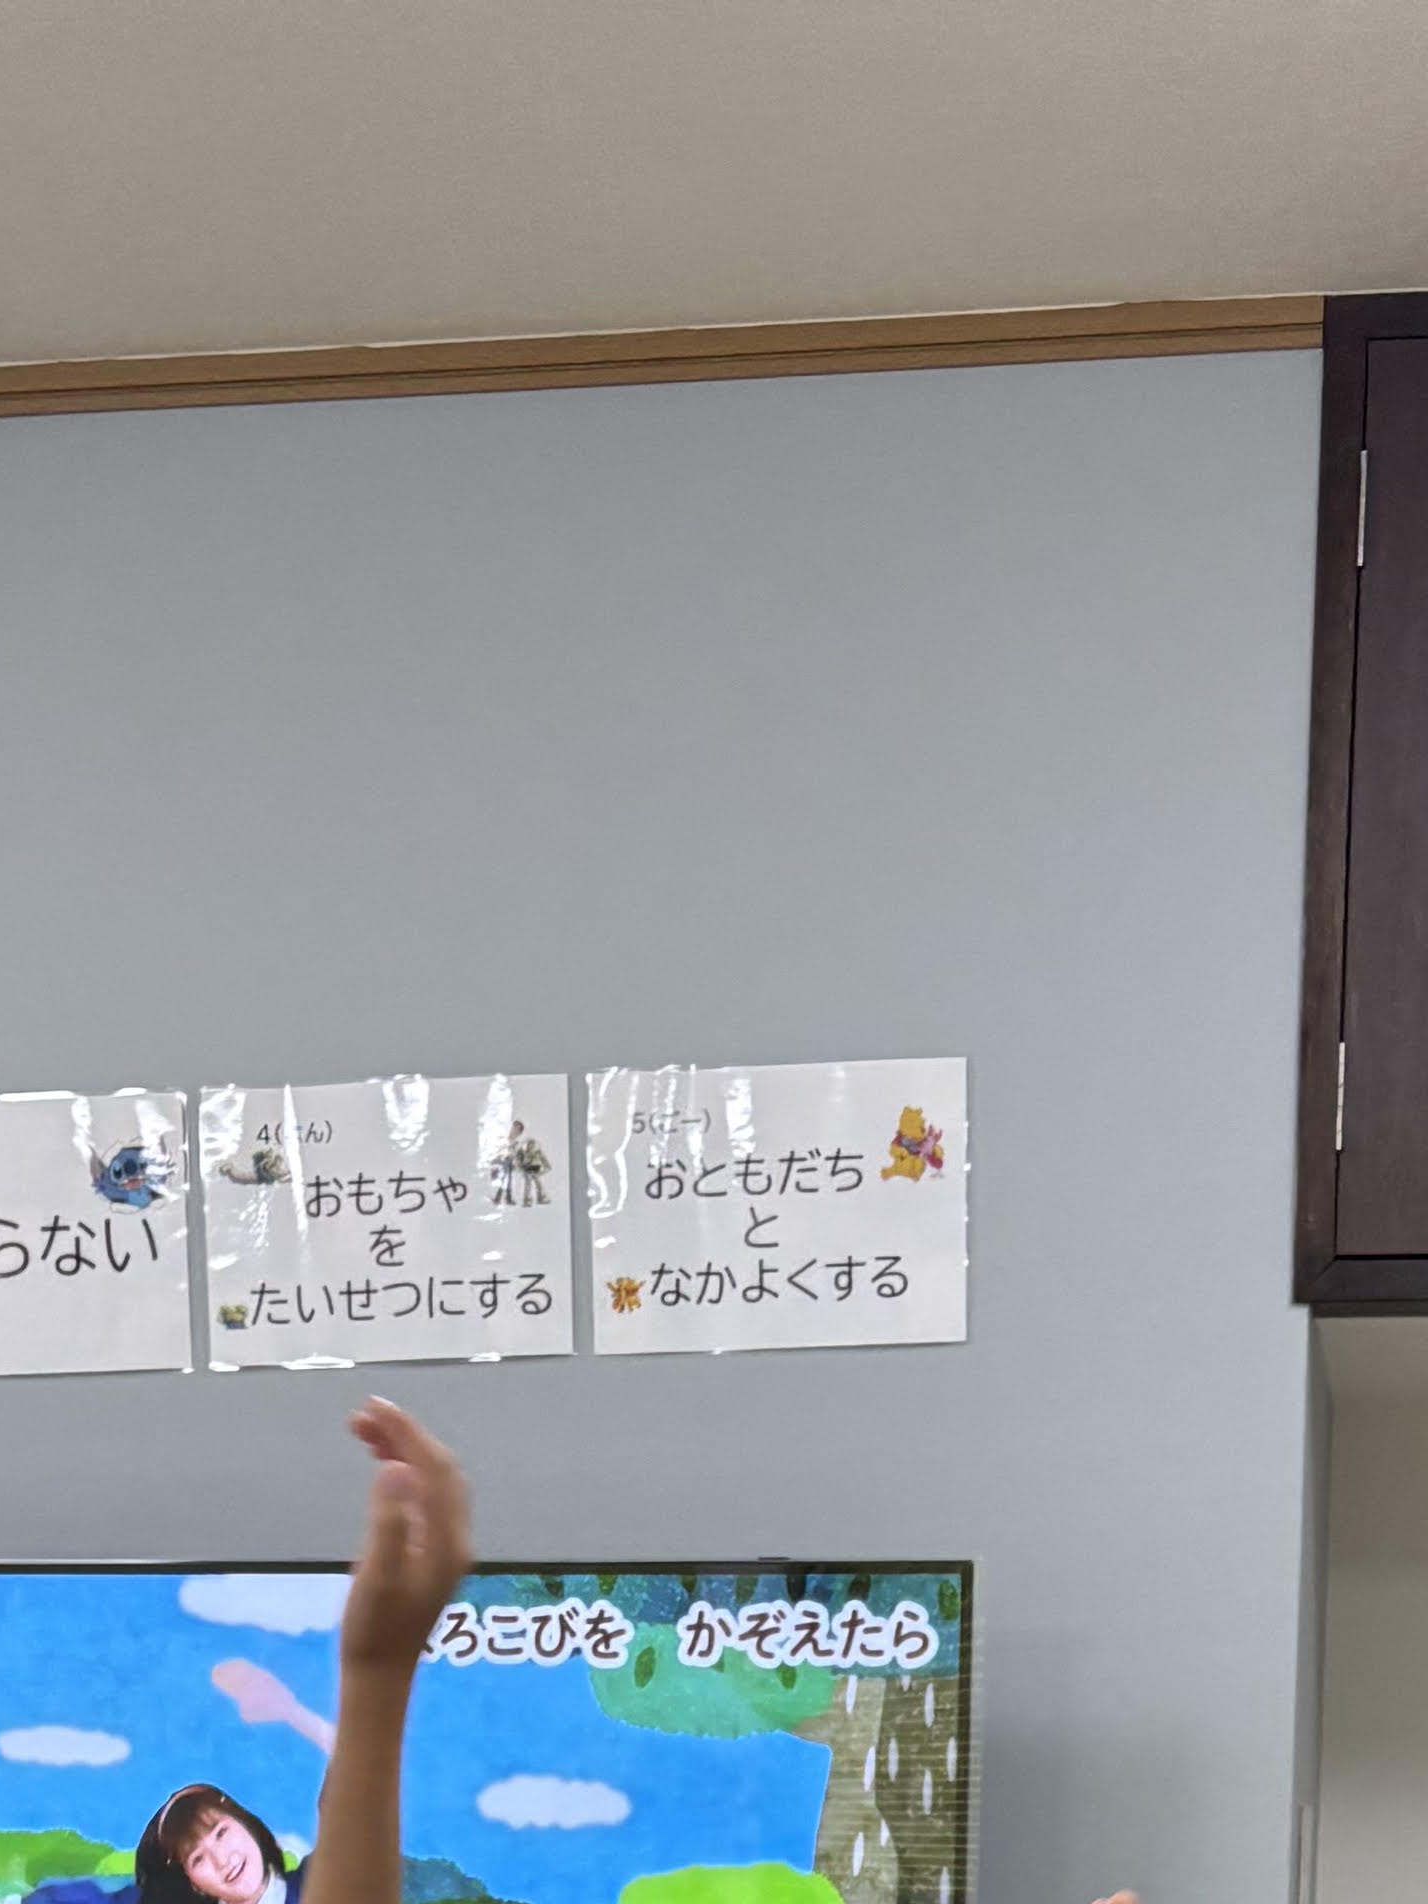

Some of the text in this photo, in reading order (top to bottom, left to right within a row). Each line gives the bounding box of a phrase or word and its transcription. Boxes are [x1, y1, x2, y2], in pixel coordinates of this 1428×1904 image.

[256, 1118, 333, 1146] 4(ん)
[305, 1170, 468, 1218] おもちゃ
[644, 1147, 865, 1200] おともだち
[369, 1224, 407, 1267] を
[744, 1206, 780, 1249] と
[250, 1272, 553, 1326] たいせつにする
[649, 1255, 910, 1308] なかよくする
[423, 1605, 931, 1661] ろこびを かぞえたら
